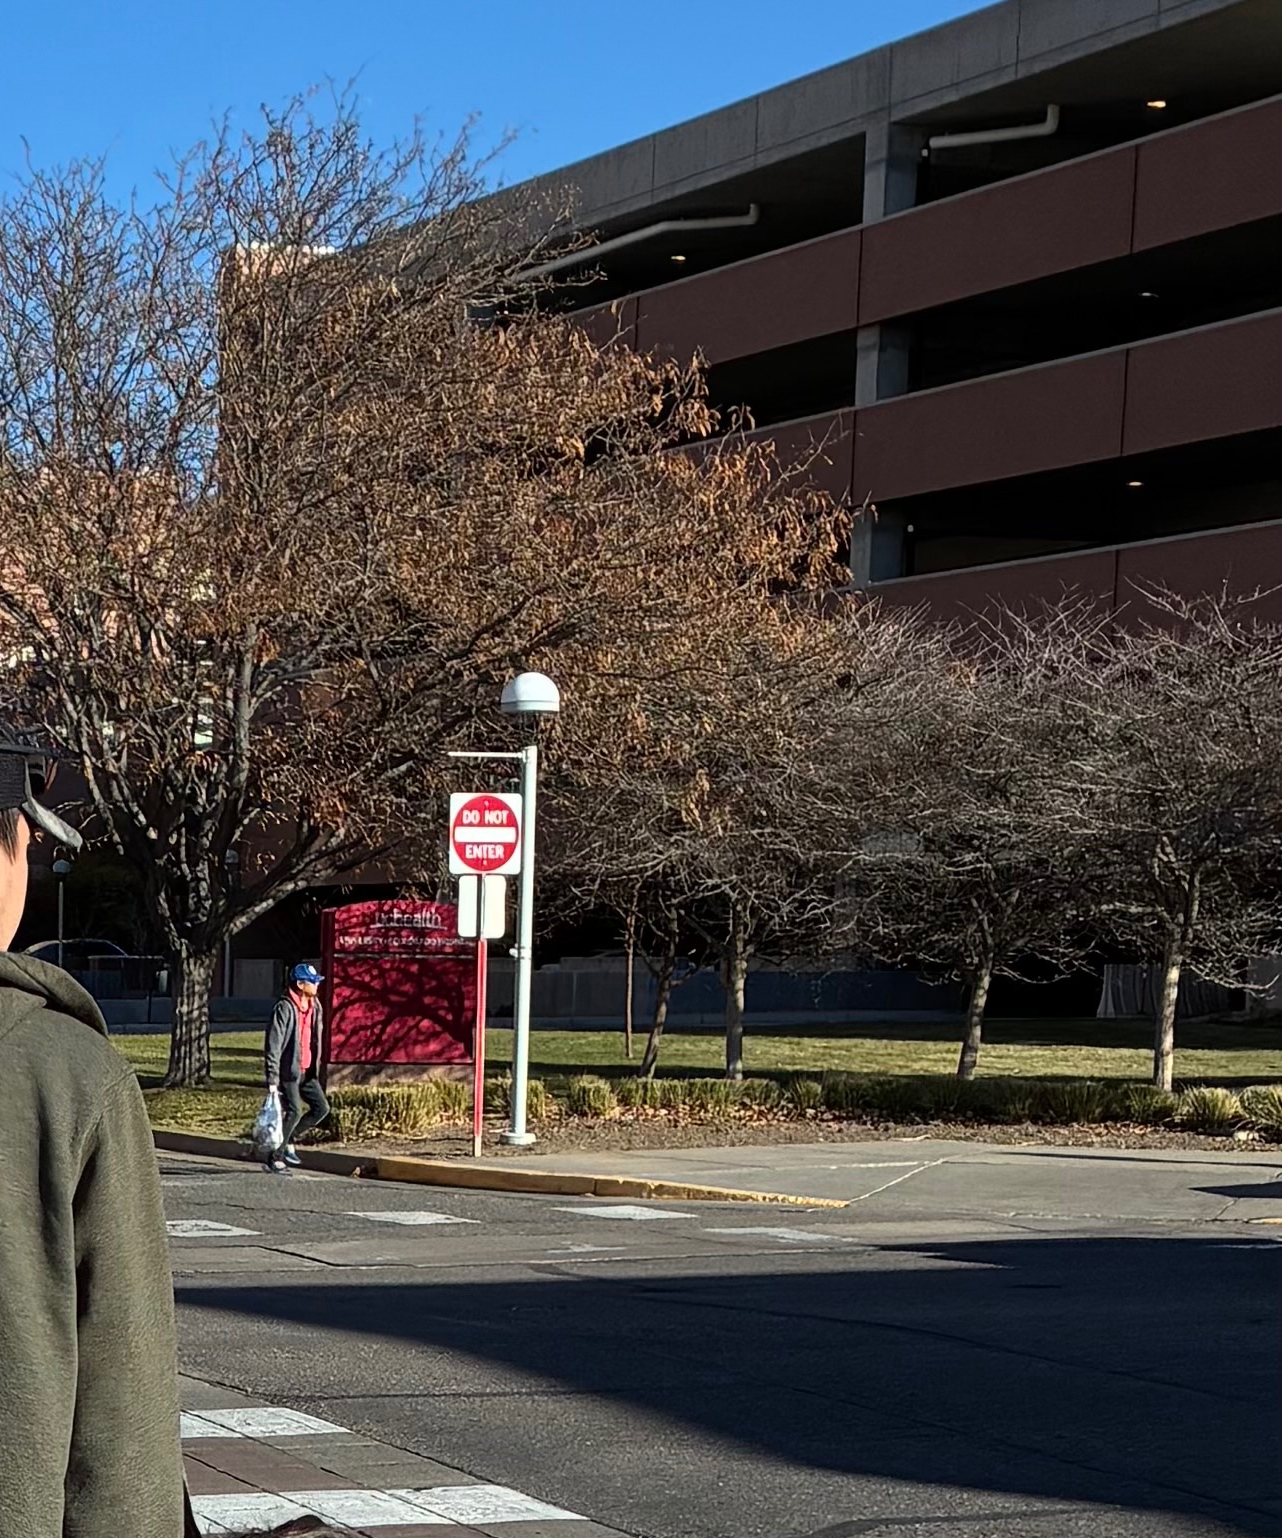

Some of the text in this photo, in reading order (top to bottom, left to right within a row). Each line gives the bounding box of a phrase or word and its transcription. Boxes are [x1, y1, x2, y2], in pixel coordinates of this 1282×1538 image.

[462, 809, 510, 825] DO NOT
[465, 844, 505, 859] ENTER
